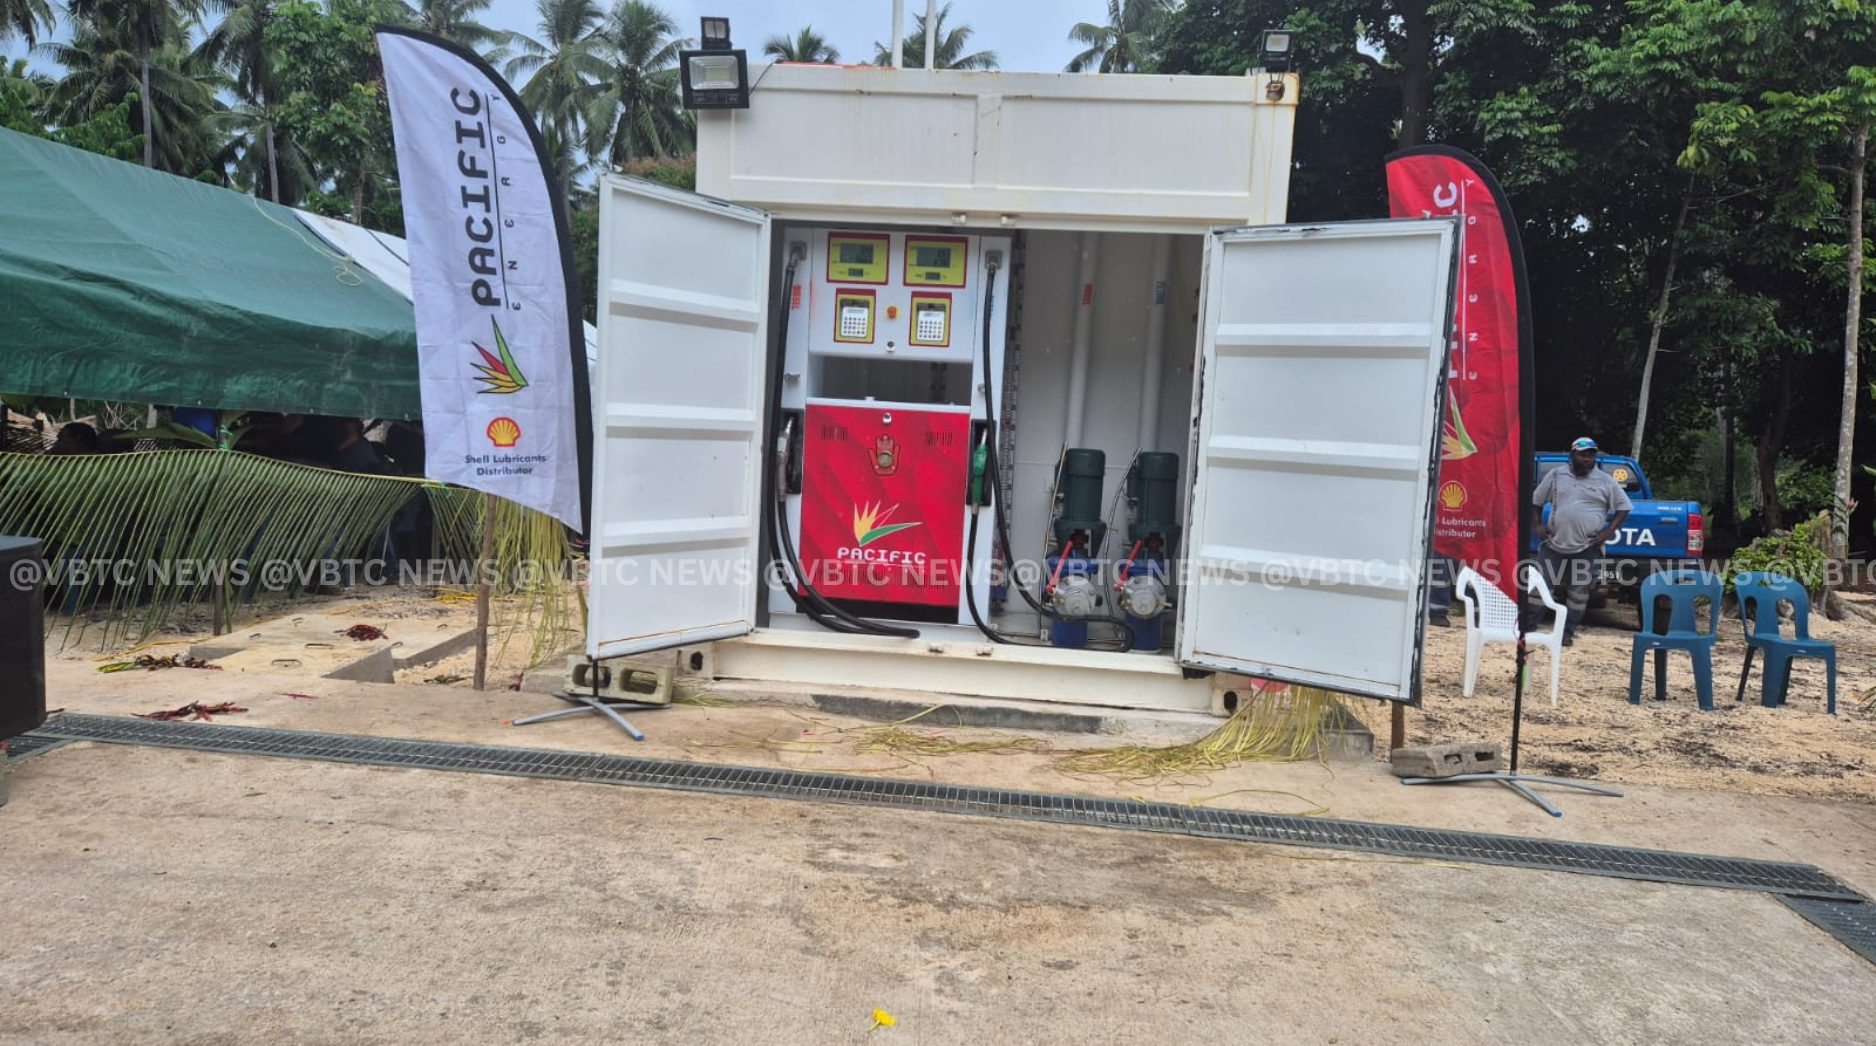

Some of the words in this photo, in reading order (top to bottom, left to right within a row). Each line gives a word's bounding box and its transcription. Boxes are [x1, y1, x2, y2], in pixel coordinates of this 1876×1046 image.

[450, 87, 502, 307] PACIFIC
[465, 454, 490, 464] Shell
[493, 454, 547, 463] Lubricants
[476, 466, 533, 476] Distributor
[1441, 516, 1486, 527] Lubricants
[1434, 528, 1477, 538] istributor
[1604, 528, 1656, 546] OTA
[837, 547, 926, 565] PACIFIC
